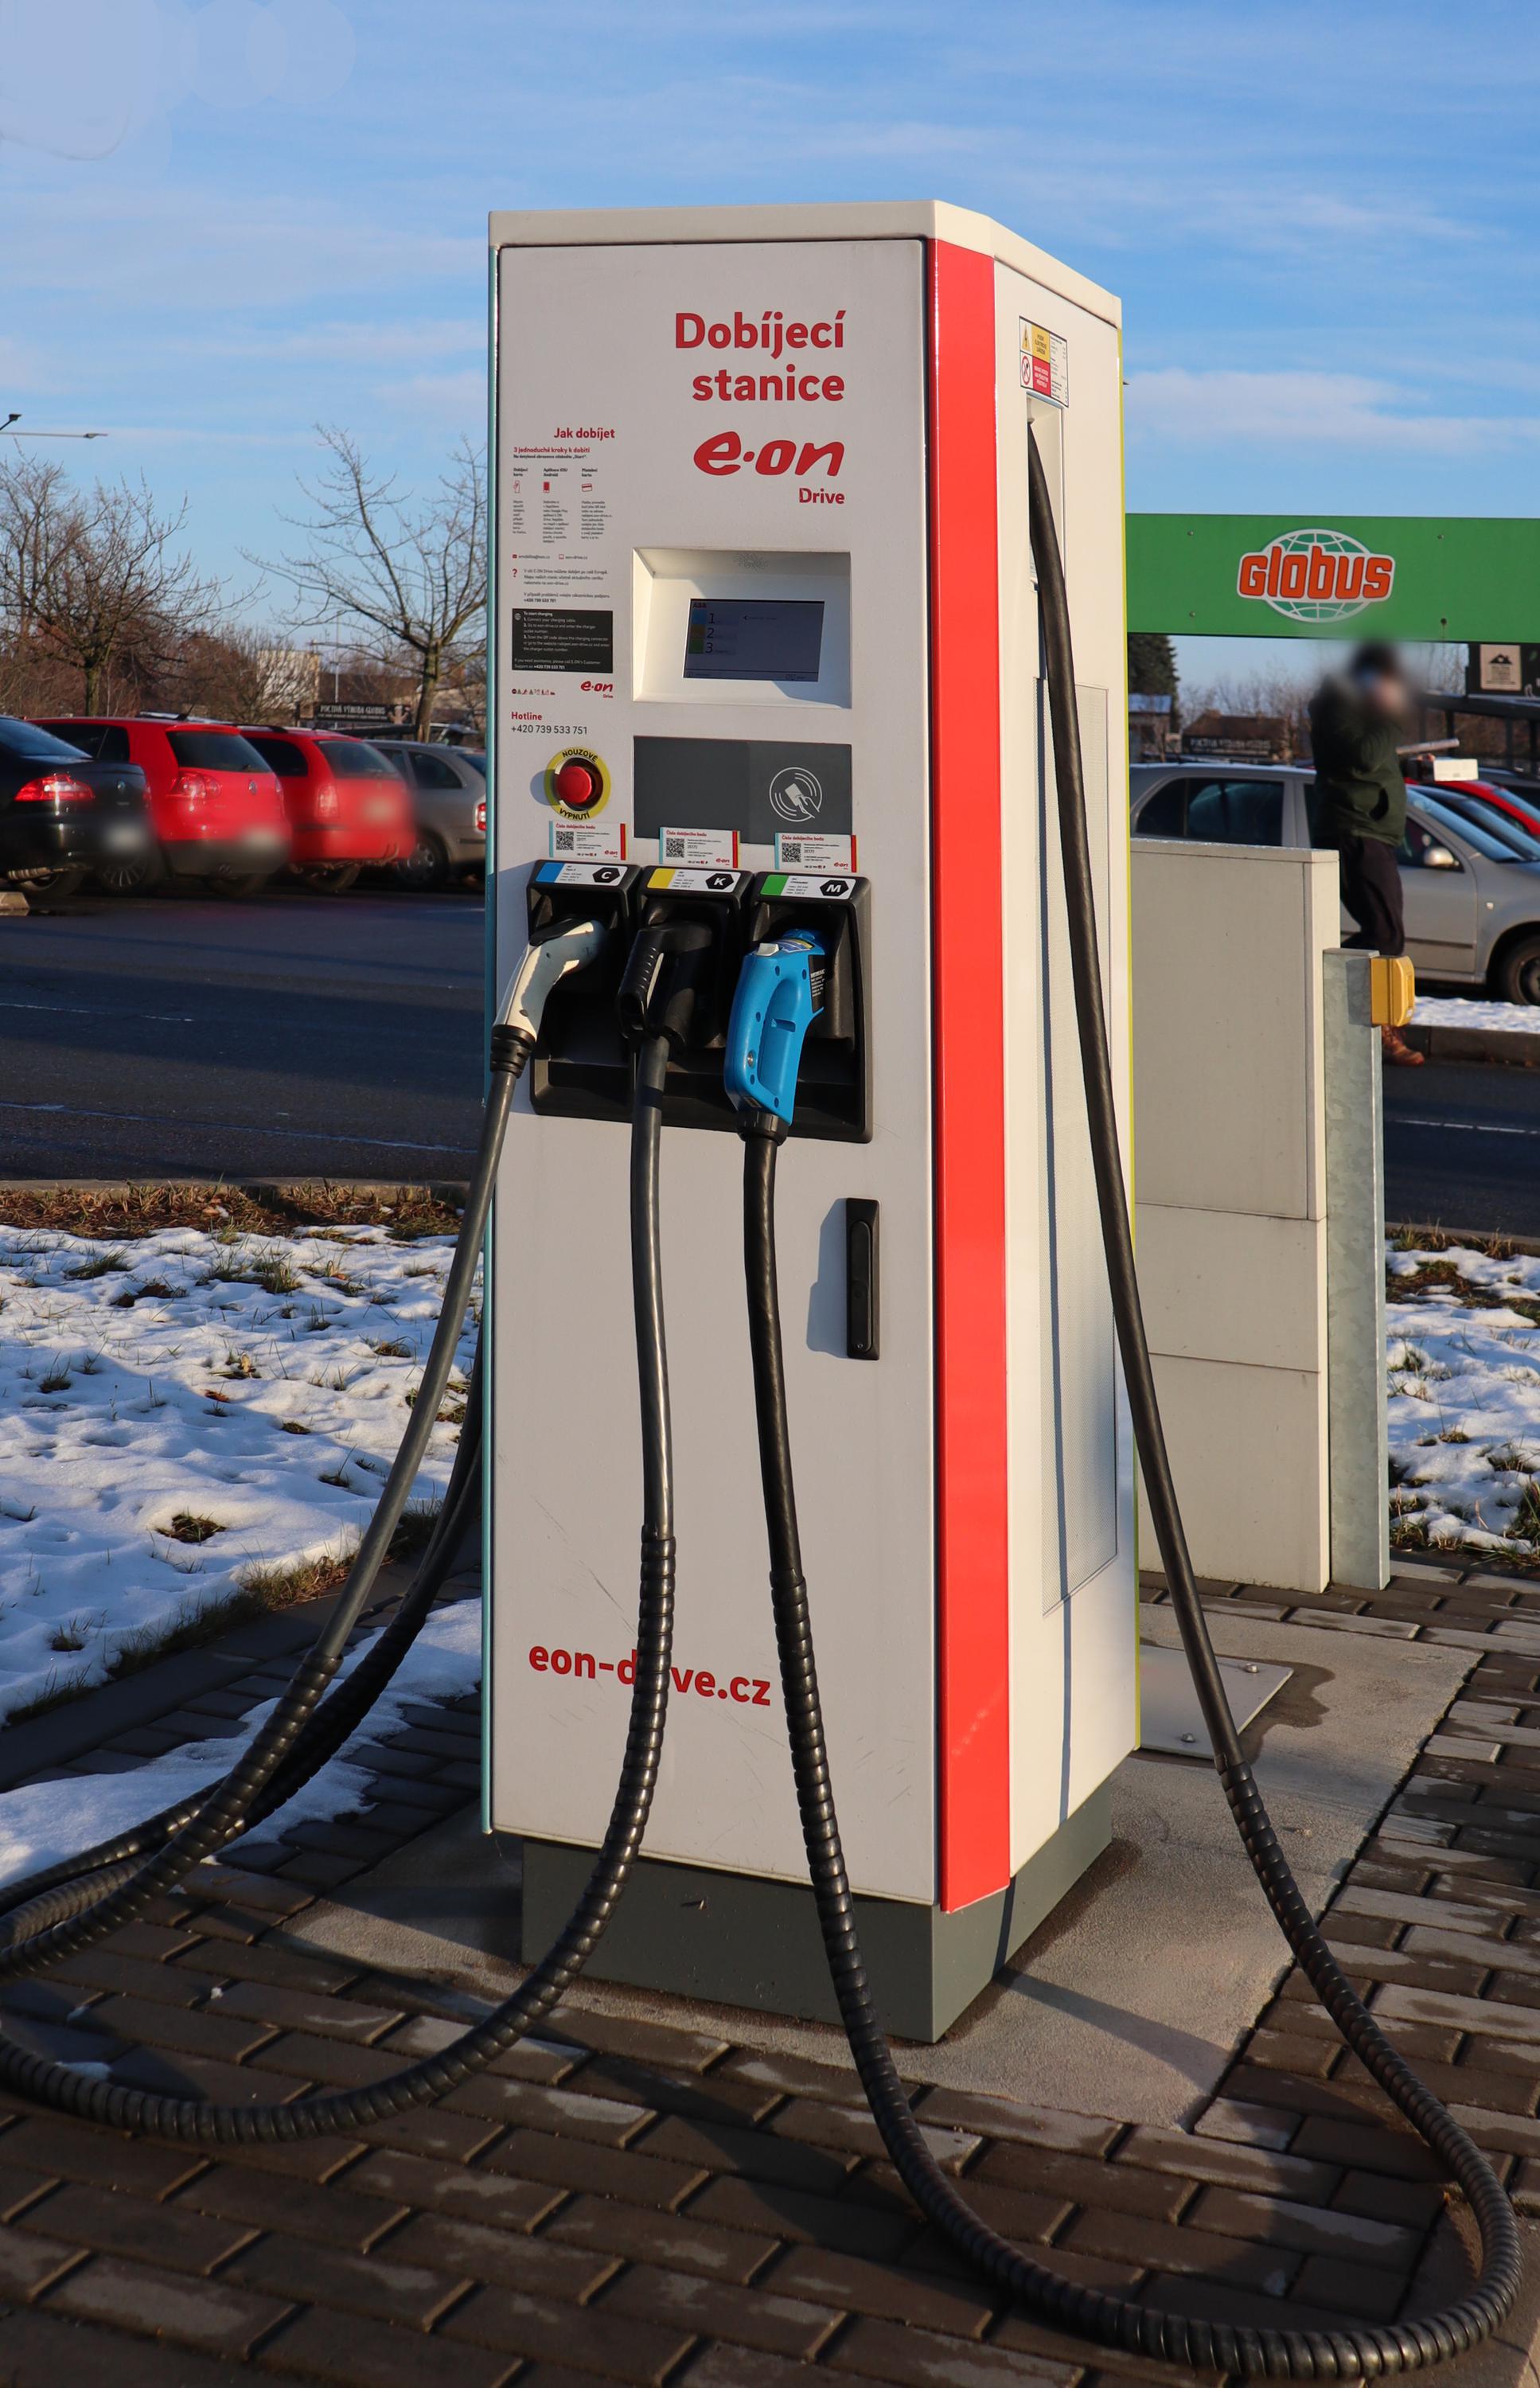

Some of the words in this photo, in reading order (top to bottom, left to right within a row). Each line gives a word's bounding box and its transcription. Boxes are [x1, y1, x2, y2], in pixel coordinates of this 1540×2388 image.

[676, 310, 847, 359] Dobíjecí
[692, 365, 845, 402] stanice
[554, 427, 574, 439] Jak
[575, 427, 615, 441] dobíjet
[799, 488, 845, 505] Drive
[1239, 544, 1392, 599] Globus
[708, 613, 715, 624] 1
[707, 628, 714, 638] 2
[705, 642, 713, 654] 3
[536, 725, 552, 734] 739
[554, 726, 571, 735] 533
[573, 726, 587, 735] 751
[562, 749, 598, 763] NOUZOVÉ
[559, 808, 590, 820] VYPNUTÍ
[529, 1645, 771, 1706] eon-dve.cz
